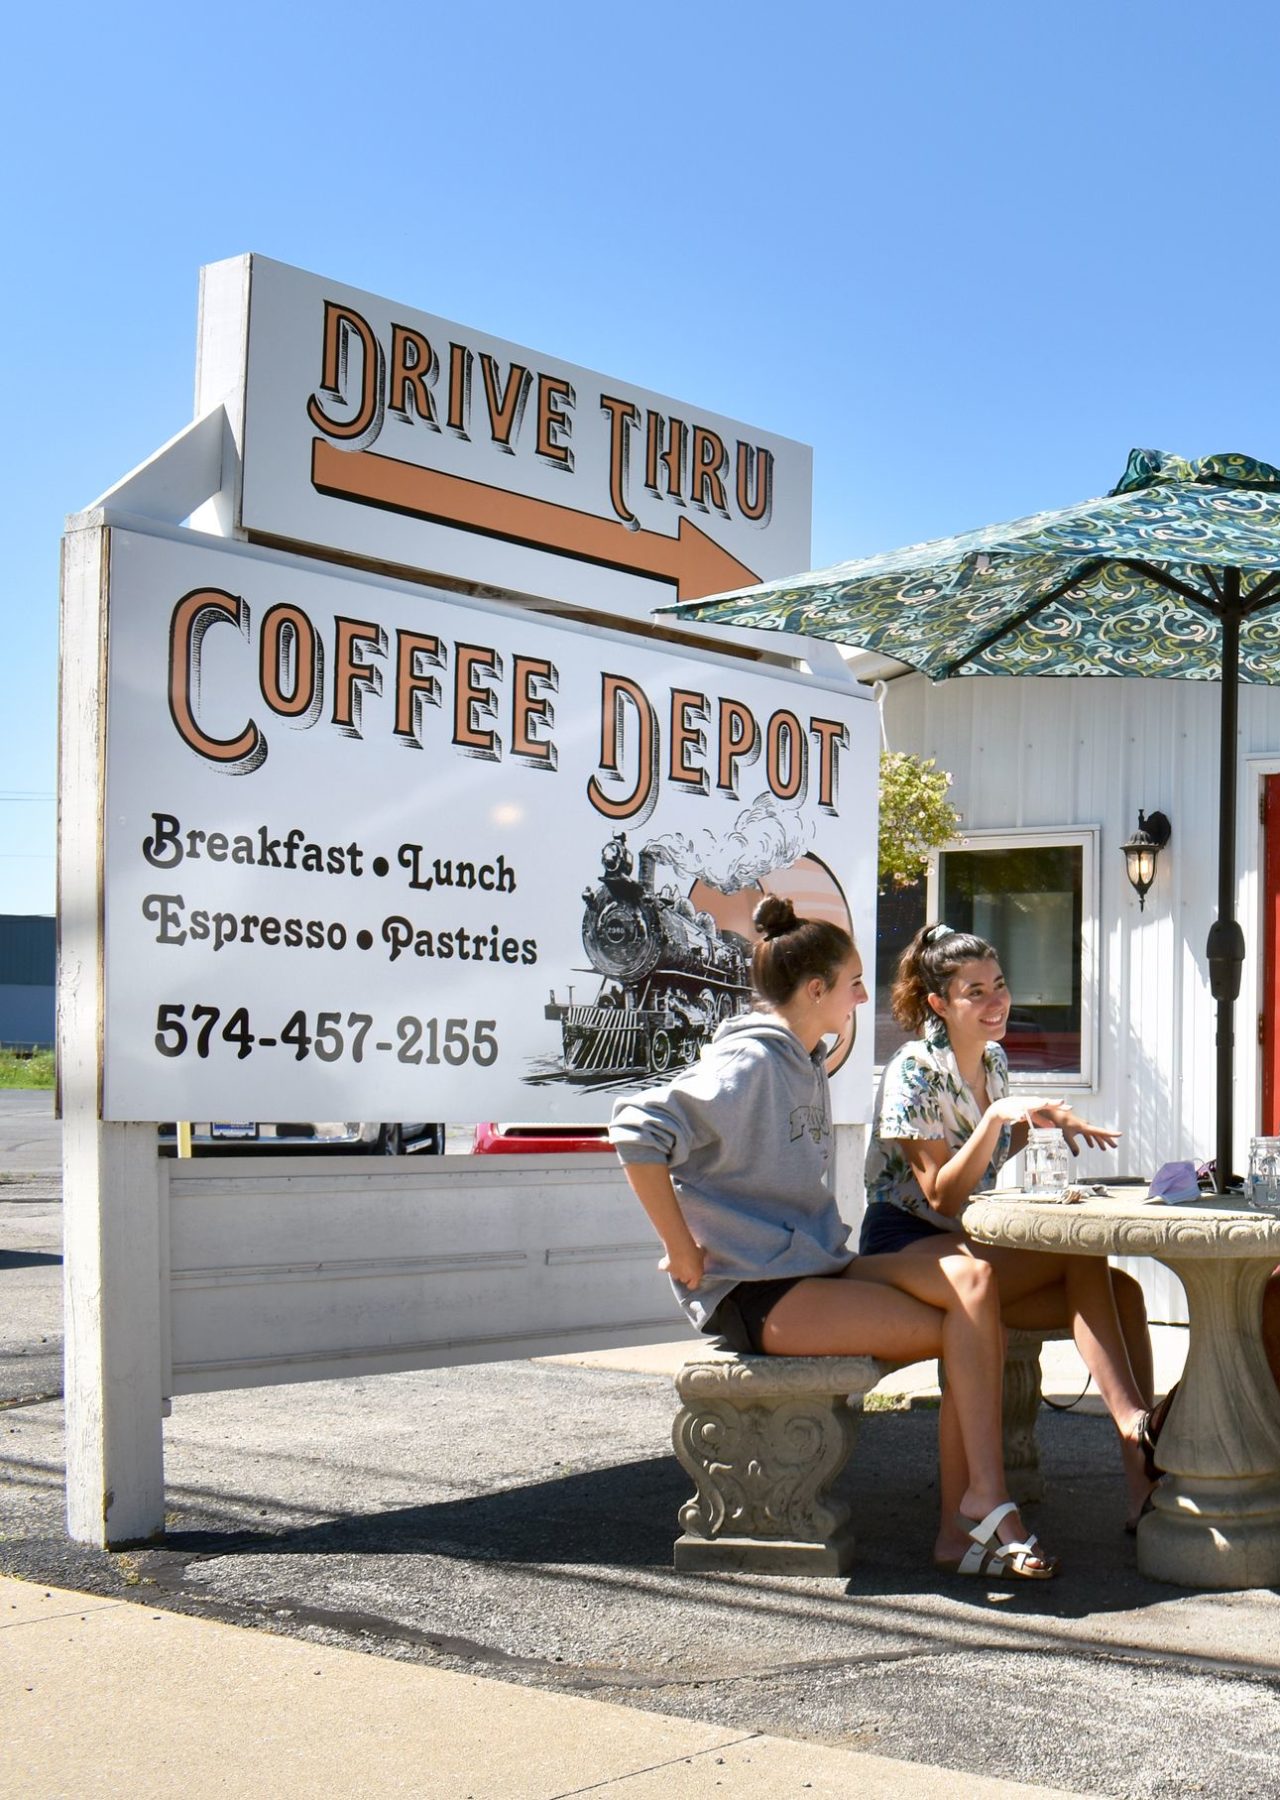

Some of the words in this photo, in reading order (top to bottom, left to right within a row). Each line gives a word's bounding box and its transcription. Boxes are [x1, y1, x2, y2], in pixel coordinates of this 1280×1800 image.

[307, 299, 576, 472] DRIVE
[600, 393, 774, 531] THRU
[168, 587, 561, 775] COFFEE
[586, 671, 852, 828] DEPOT
[143, 812, 364, 877] Breakfast
[397, 843, 517, 894] Lunch
[142, 894, 347, 952] Espresso
[381, 915, 538, 965] Pastries
[155, 1003, 499, 1067] 574-457-2155
